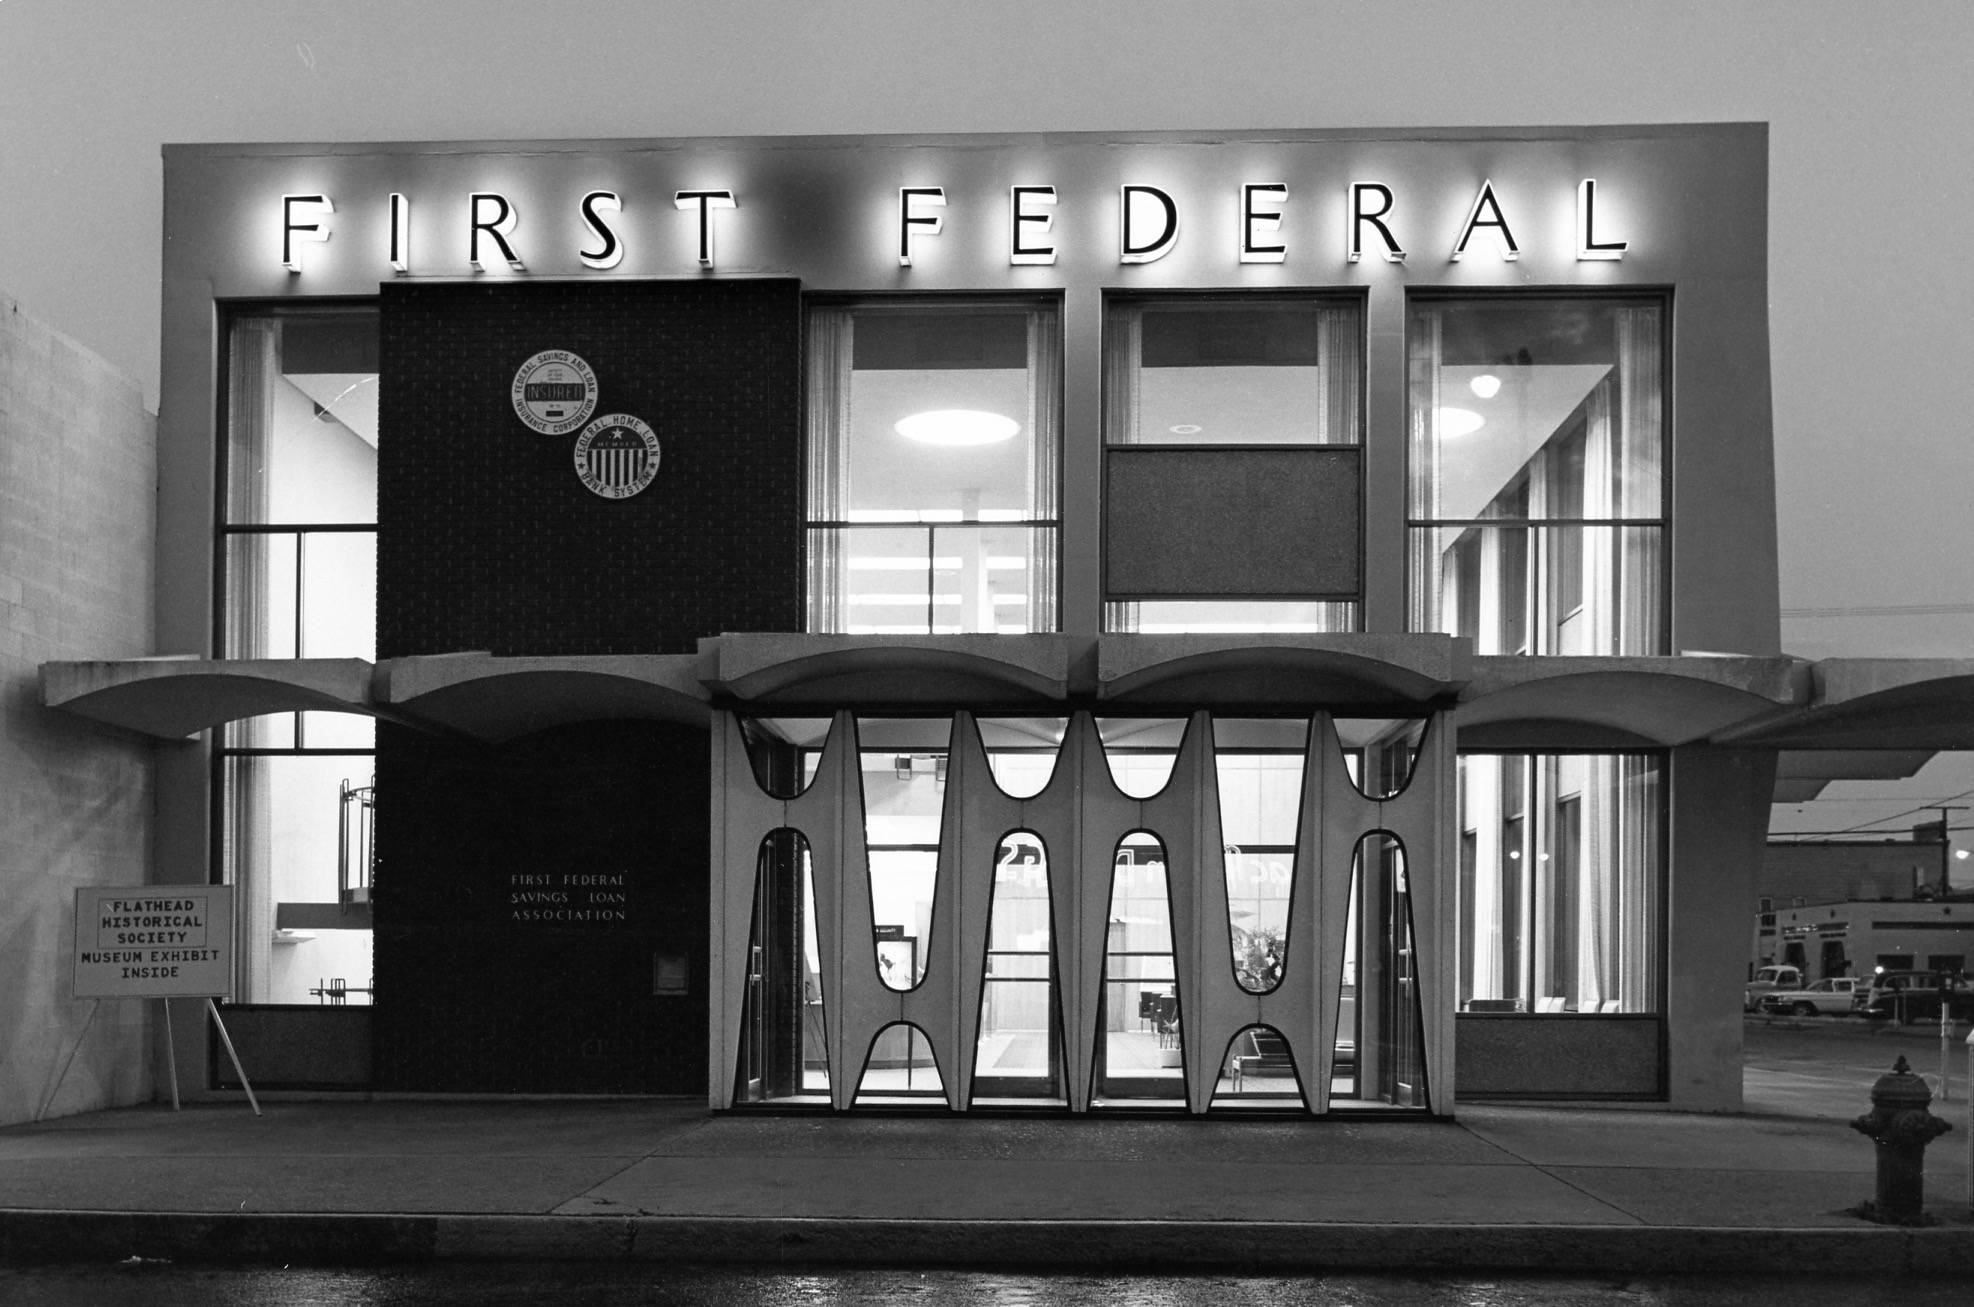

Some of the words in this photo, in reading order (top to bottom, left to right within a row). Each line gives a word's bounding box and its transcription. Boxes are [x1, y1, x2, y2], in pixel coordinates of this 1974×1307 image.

[282, 188, 739, 272] FIRST
[899, 178, 1629, 267] FEDERAL
[515, 362, 537, 394] FEDERAL
[537, 352, 569, 364] SAVINGS
[570, 357, 585, 373] AND
[583, 371, 596, 393] LOAN
[527, 384, 583, 400] INSURED
[515, 398, 547, 432] INSURANCE
[553, 398, 595, 433] CORPORATION
[576, 419, 609, 458] FEDERAL
[613, 415, 641, 431] HOME
[643, 429, 659, 457] LOAN
[581, 471, 606, 495] BANK
[614, 470, 653, 498] SYSTEM
[511, 874, 551, 886] FIRST
[564, 873, 625, 886] FEDERAL
[511, 892, 568, 904] SAVINGS
[590, 892, 625, 903] LOAN
[113, 900, 195, 913] FLATHEAD
[102, 916, 203, 928] HISTORICAL
[511, 910, 625, 921] ASSOCIATION
[117, 932, 187, 944] SOCIETY
[81, 952, 143, 963] MUSEUM
[151, 950, 220, 962] EXHIBIT
[122, 967, 179, 979] INSIDE
